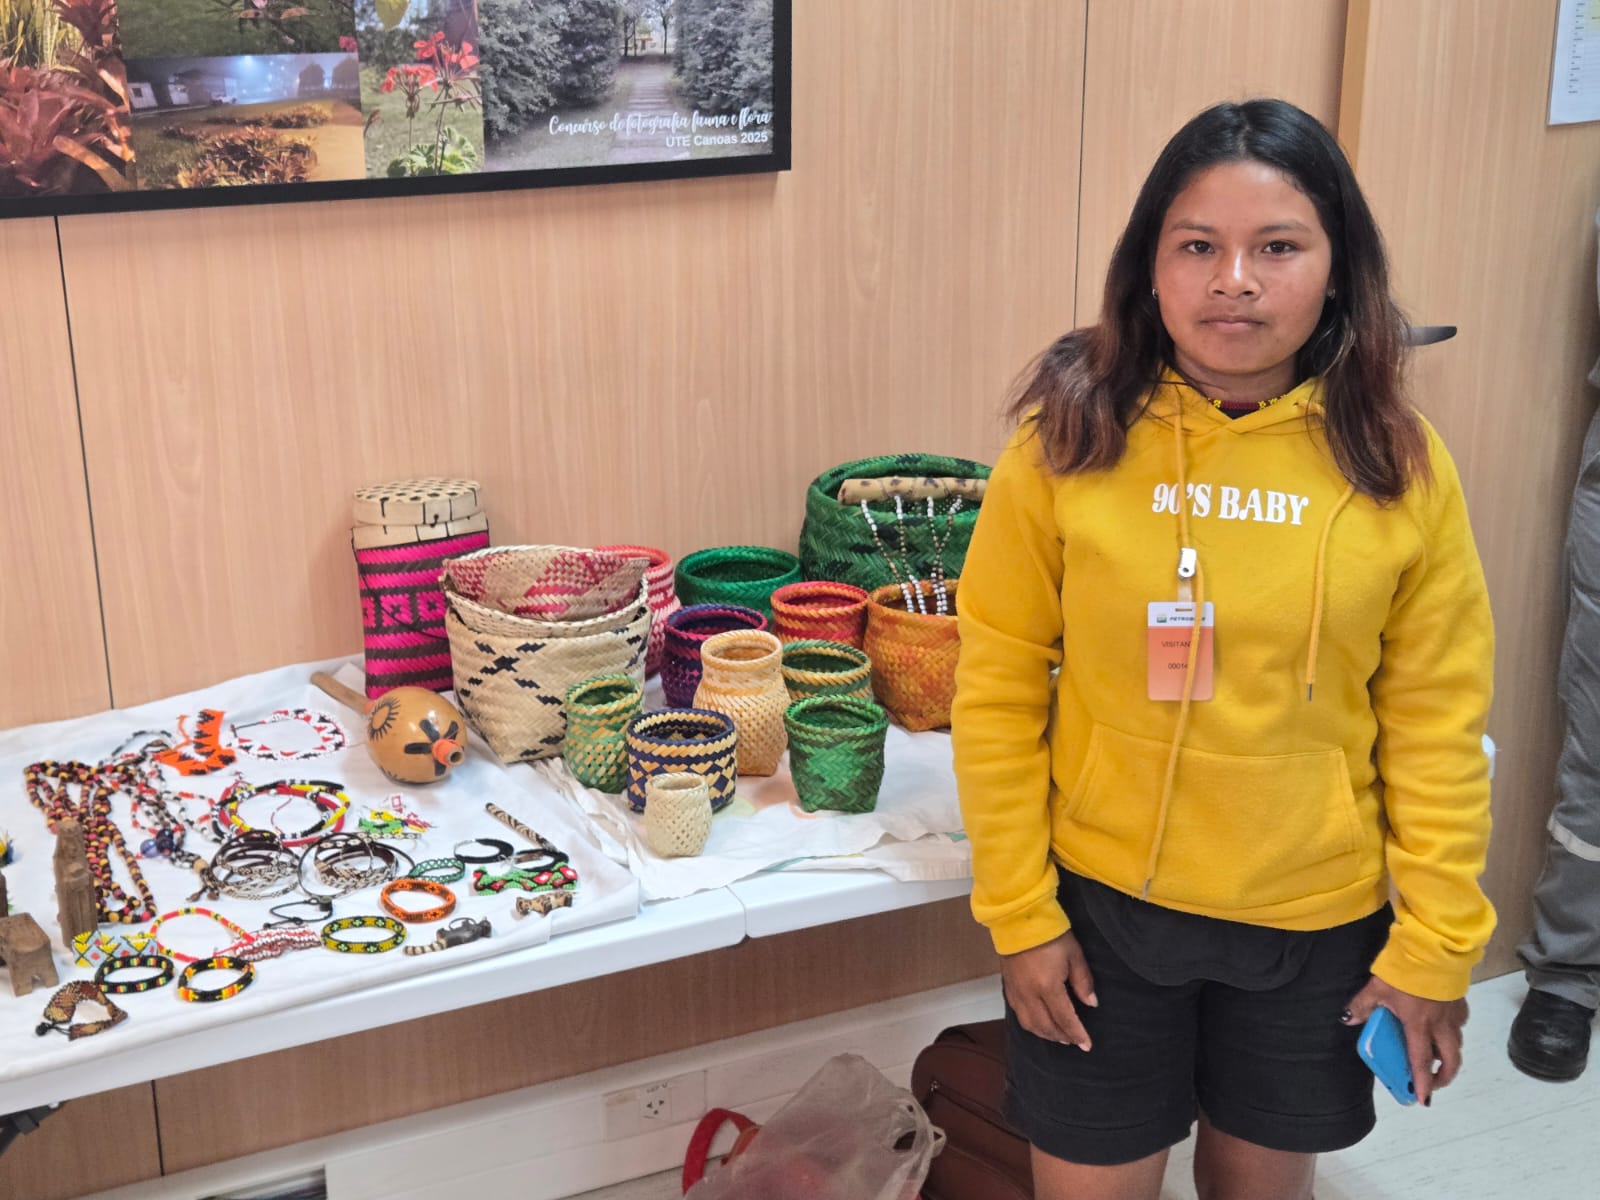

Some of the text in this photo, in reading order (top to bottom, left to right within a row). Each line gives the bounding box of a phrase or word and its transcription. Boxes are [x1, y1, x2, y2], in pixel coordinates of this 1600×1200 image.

[549, 116, 606, 135] Concurso
[610, 114, 624, 130] de
[626, 111, 689, 136] fotografia
[691, 110, 728, 133] fauna
[737, 107, 771, 131] flora
[666, 132, 768, 147] UTE Canoas 2025
[1152, 483, 1309, 525] 90'S BABY
